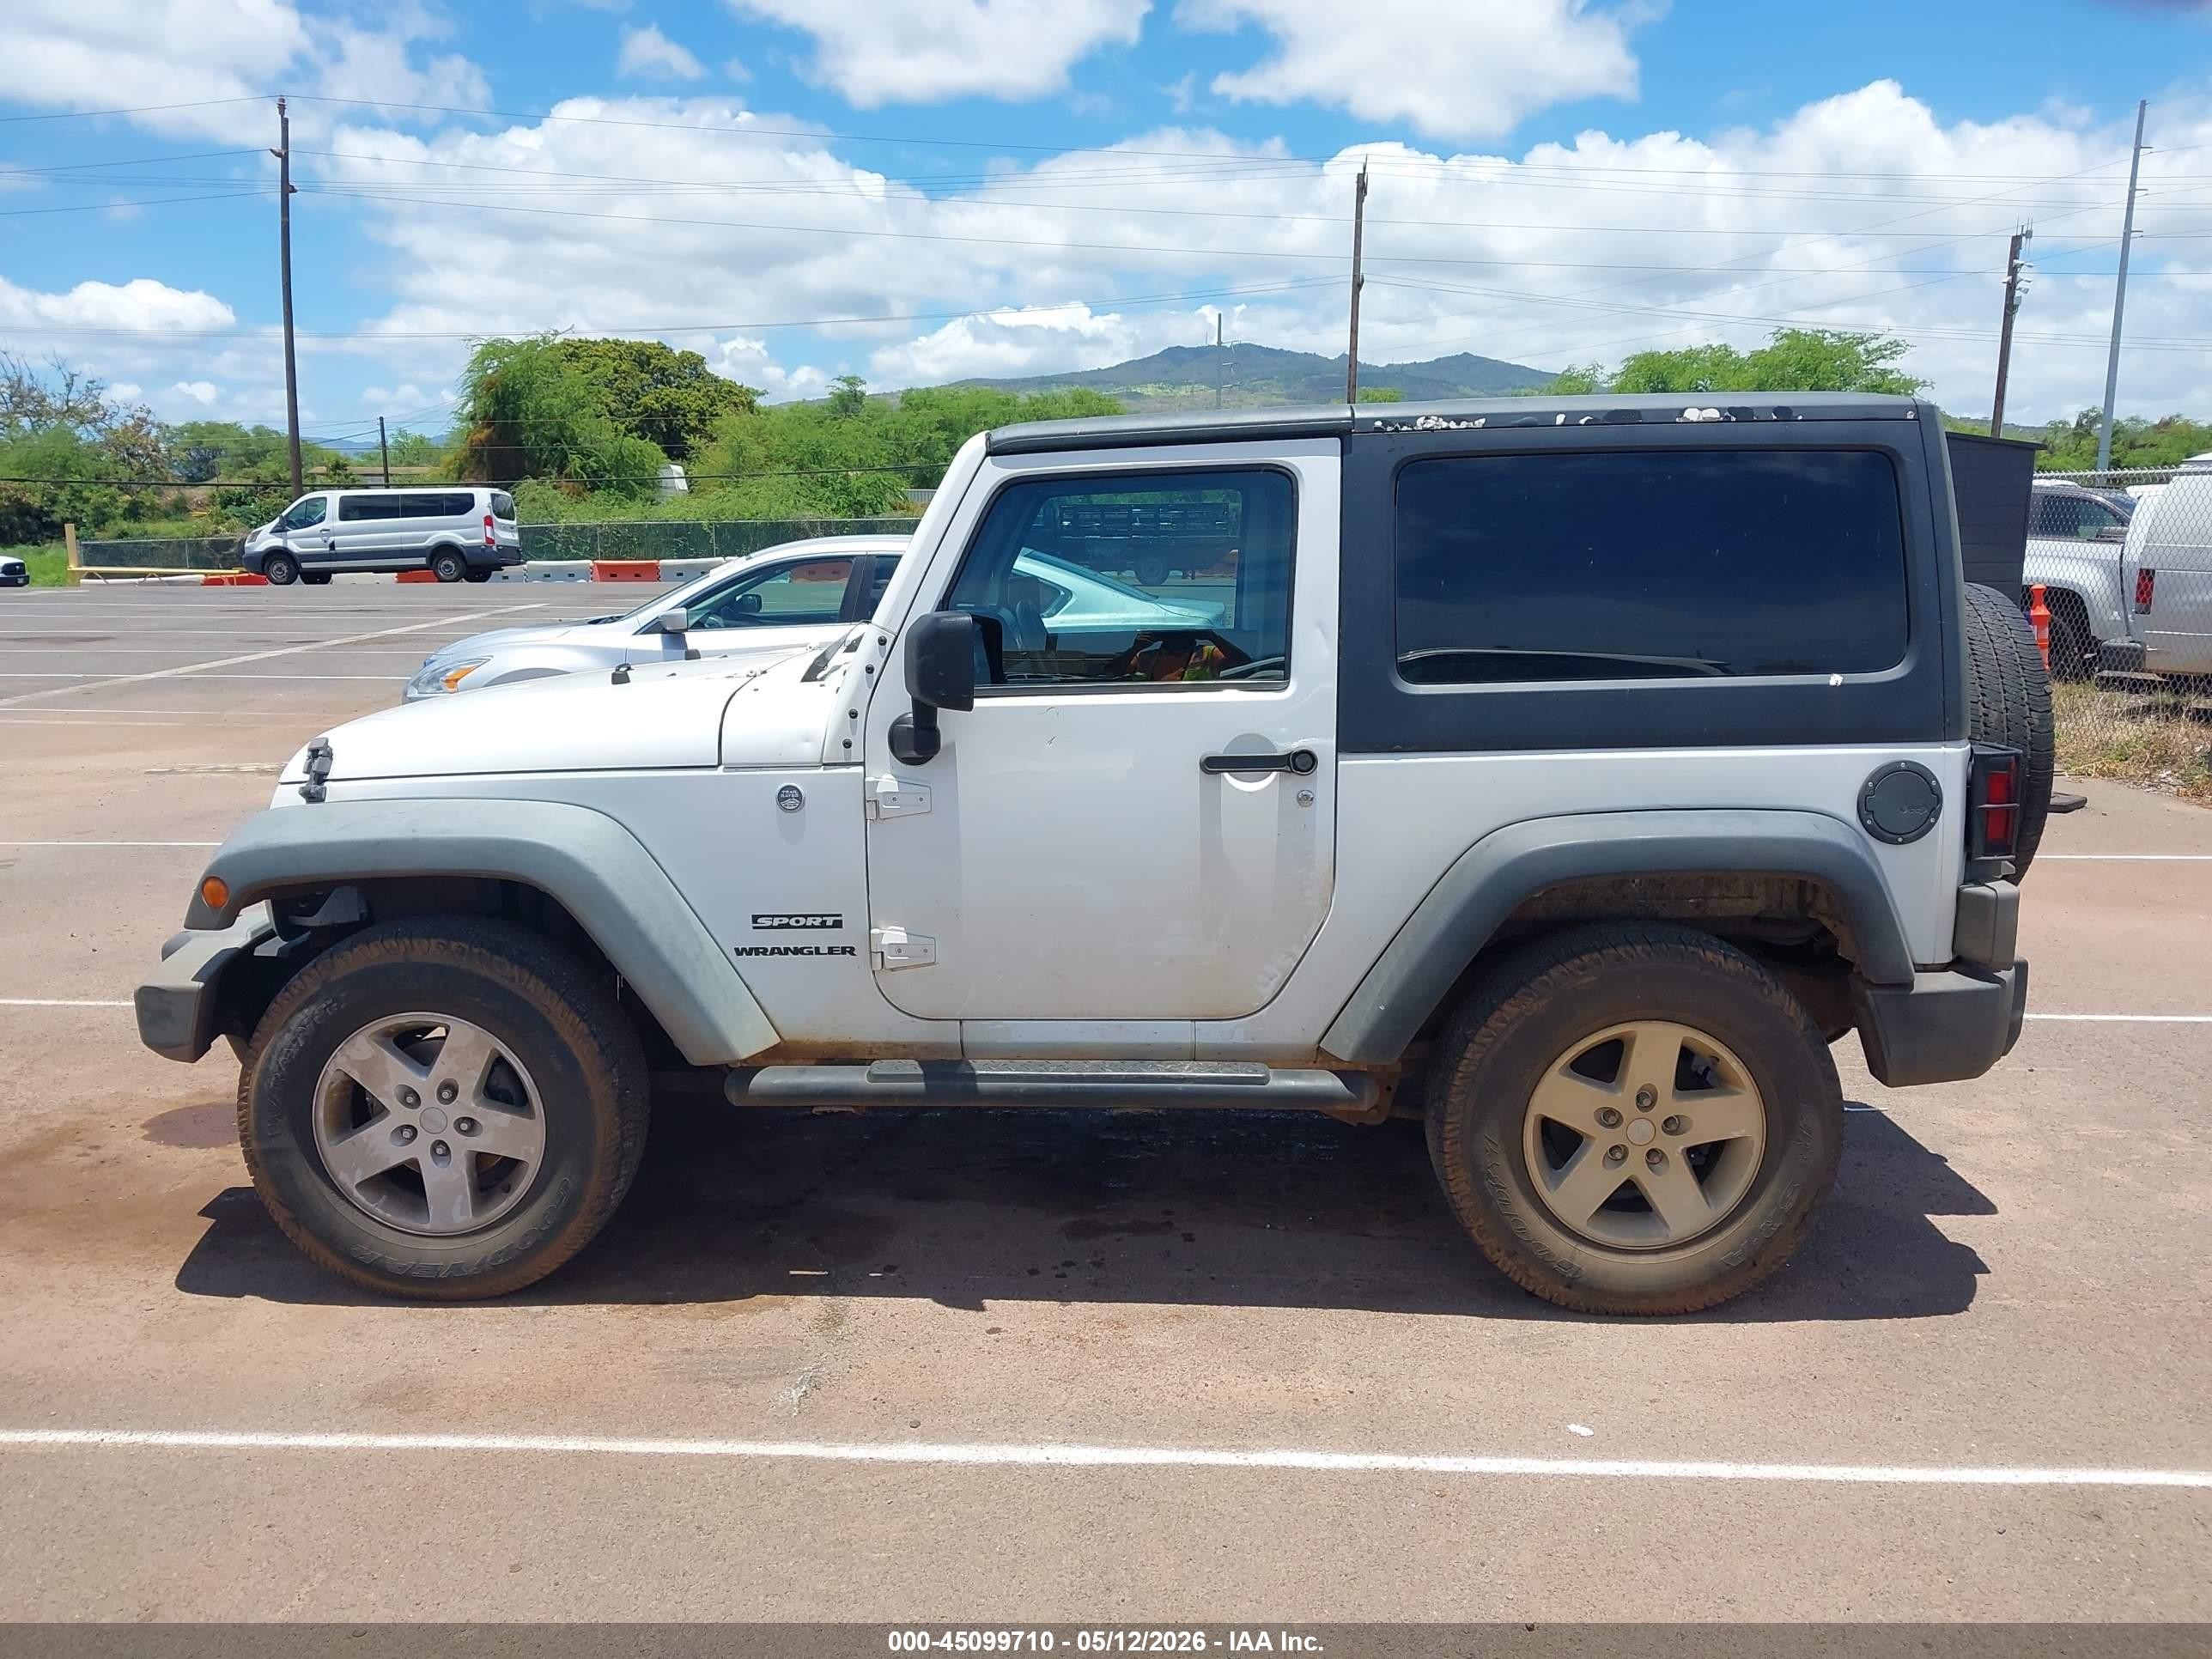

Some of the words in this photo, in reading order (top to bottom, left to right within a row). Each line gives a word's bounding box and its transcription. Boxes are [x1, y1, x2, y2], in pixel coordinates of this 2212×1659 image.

[752, 915, 843, 928] SPORT
[733, 945, 858, 957] WRANGLER
[349, 1176, 572, 1279] GOODYEAR
